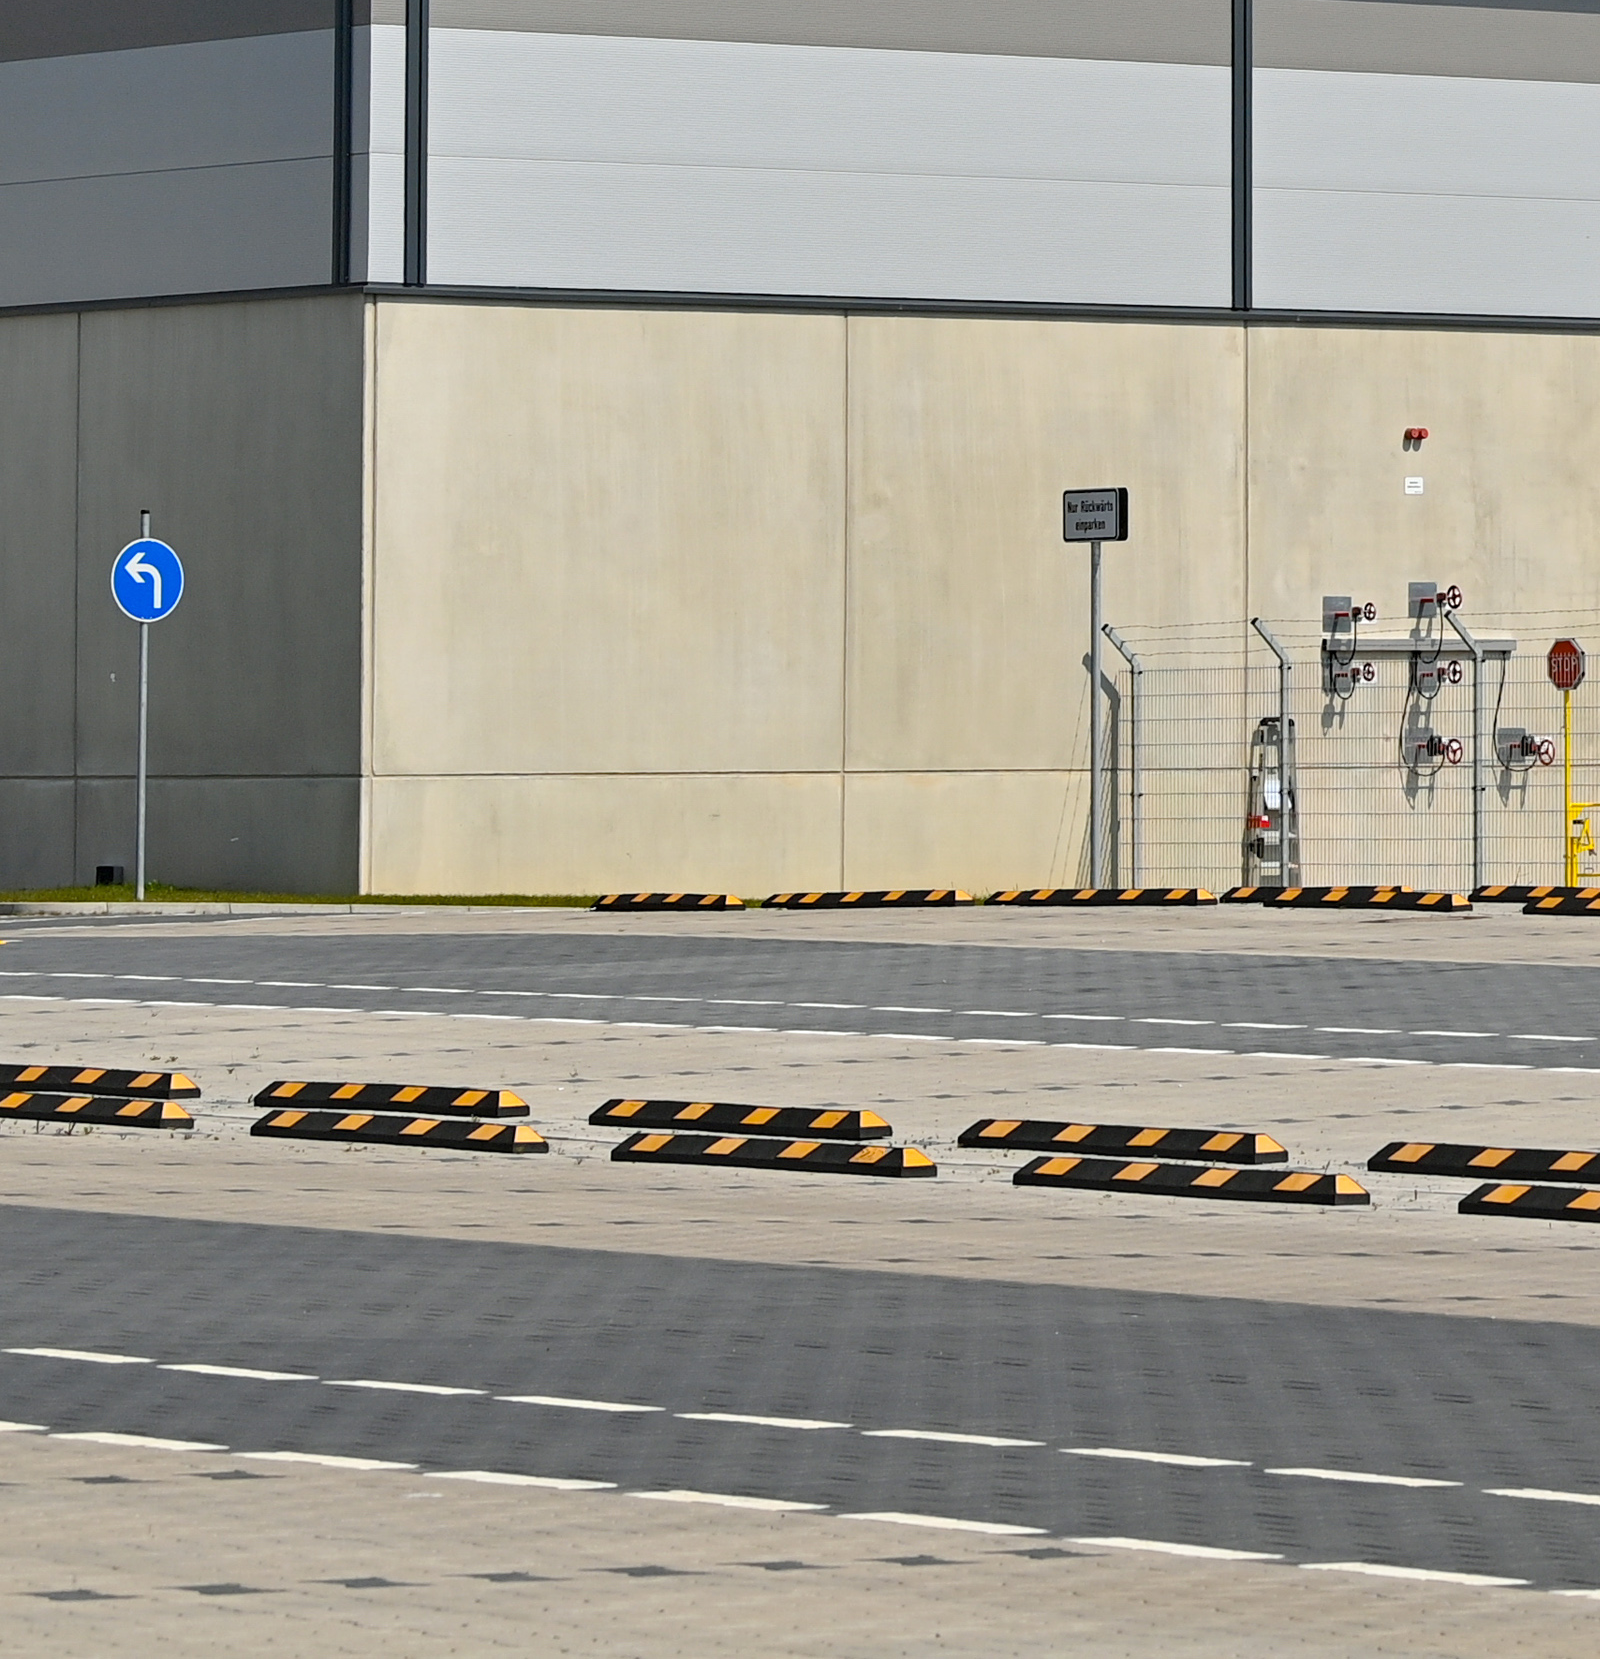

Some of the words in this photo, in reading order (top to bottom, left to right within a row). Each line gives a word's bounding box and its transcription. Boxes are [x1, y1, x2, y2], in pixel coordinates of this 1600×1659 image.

[1067, 501, 1078, 513] Nur
[1080, 500, 1113, 513] Rückwärts
[1075, 518, 1105, 533] einparken
[1552, 656, 1578, 672] STOP
